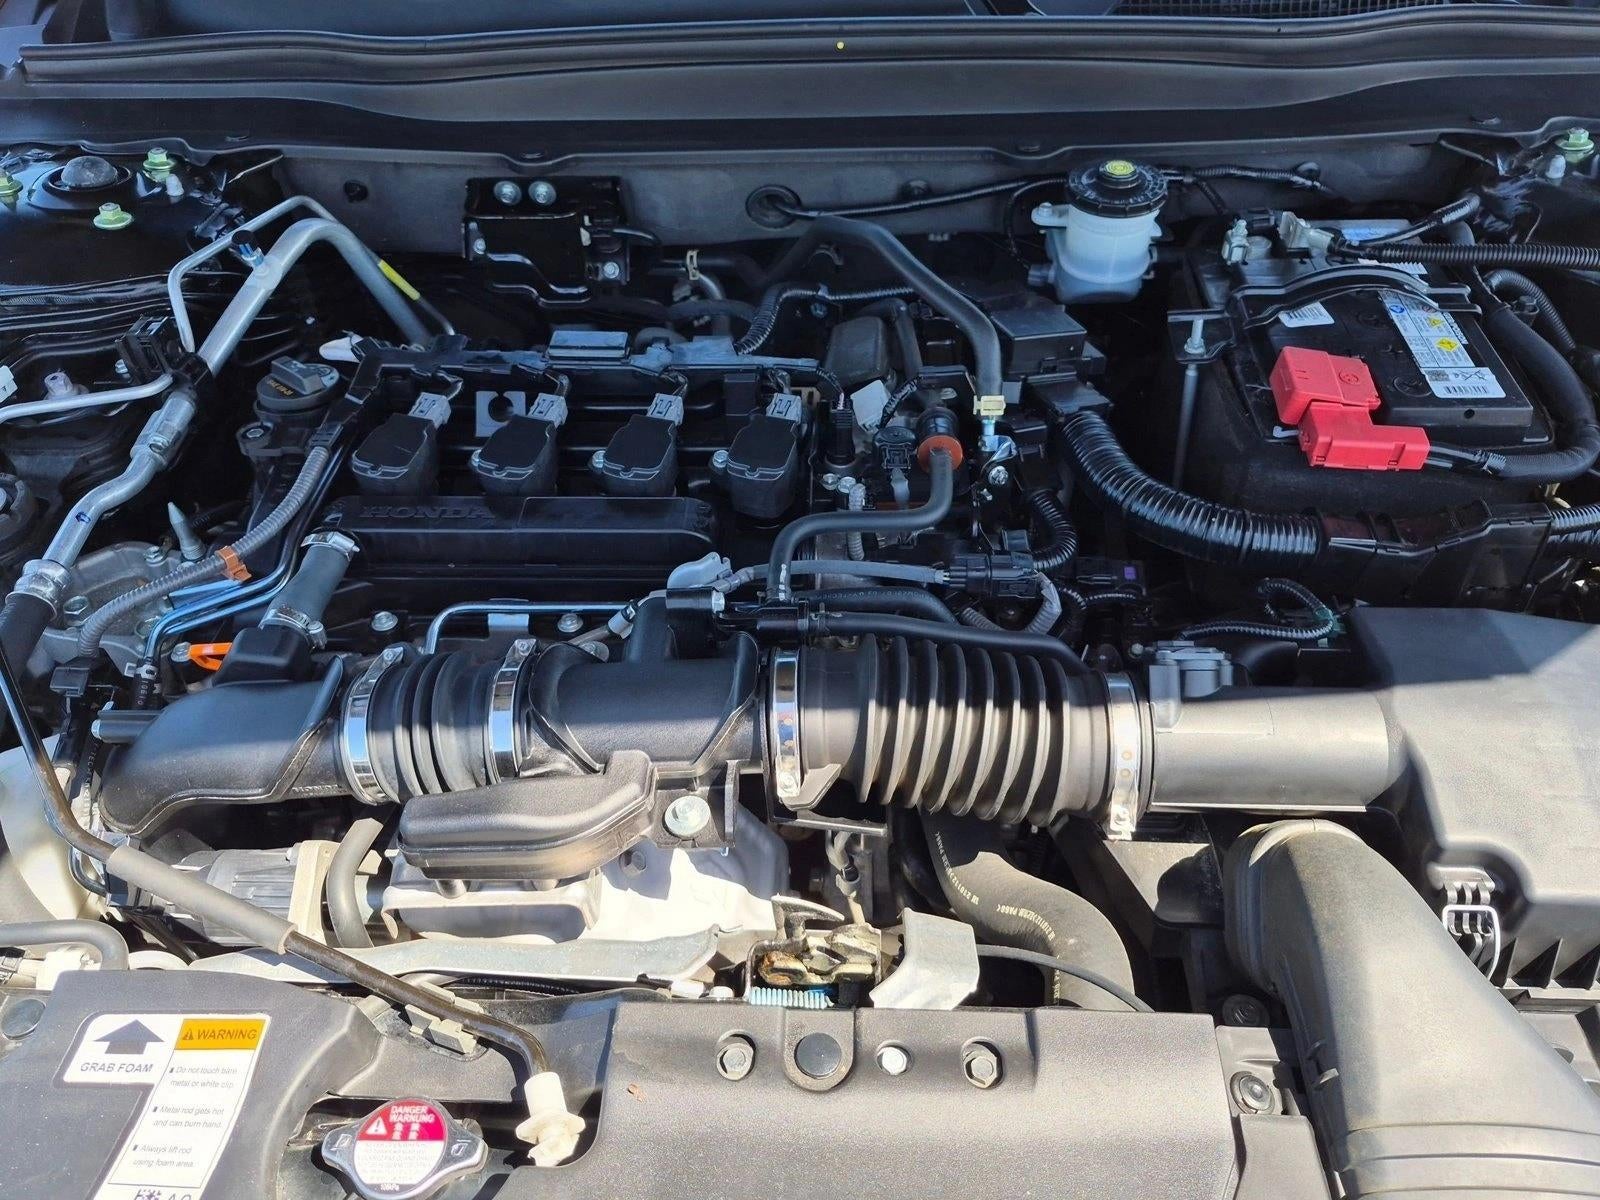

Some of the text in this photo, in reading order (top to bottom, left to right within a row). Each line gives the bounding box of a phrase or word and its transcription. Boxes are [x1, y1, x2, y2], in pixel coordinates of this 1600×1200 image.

[361, 504, 496, 520] HONDA
[197, 1029, 258, 1041] WARNING
[80, 1062, 154, 1073] GRAB FOAM
[176, 1066, 186, 1074] Do
[170, 1079, 190, 1087] metal
[200, 1080, 220, 1088] white
[159, 1105, 225, 1116] Metal rod gets hot
[391, 1105, 428, 1114] DANGER
[153, 1119, 169, 1127] and
[184, 1120, 201, 1128] burn
[140, 1144, 193, 1154] Always lift rod
[132, 1158, 155, 1168] using
[156, 1158, 175, 1167] foam
